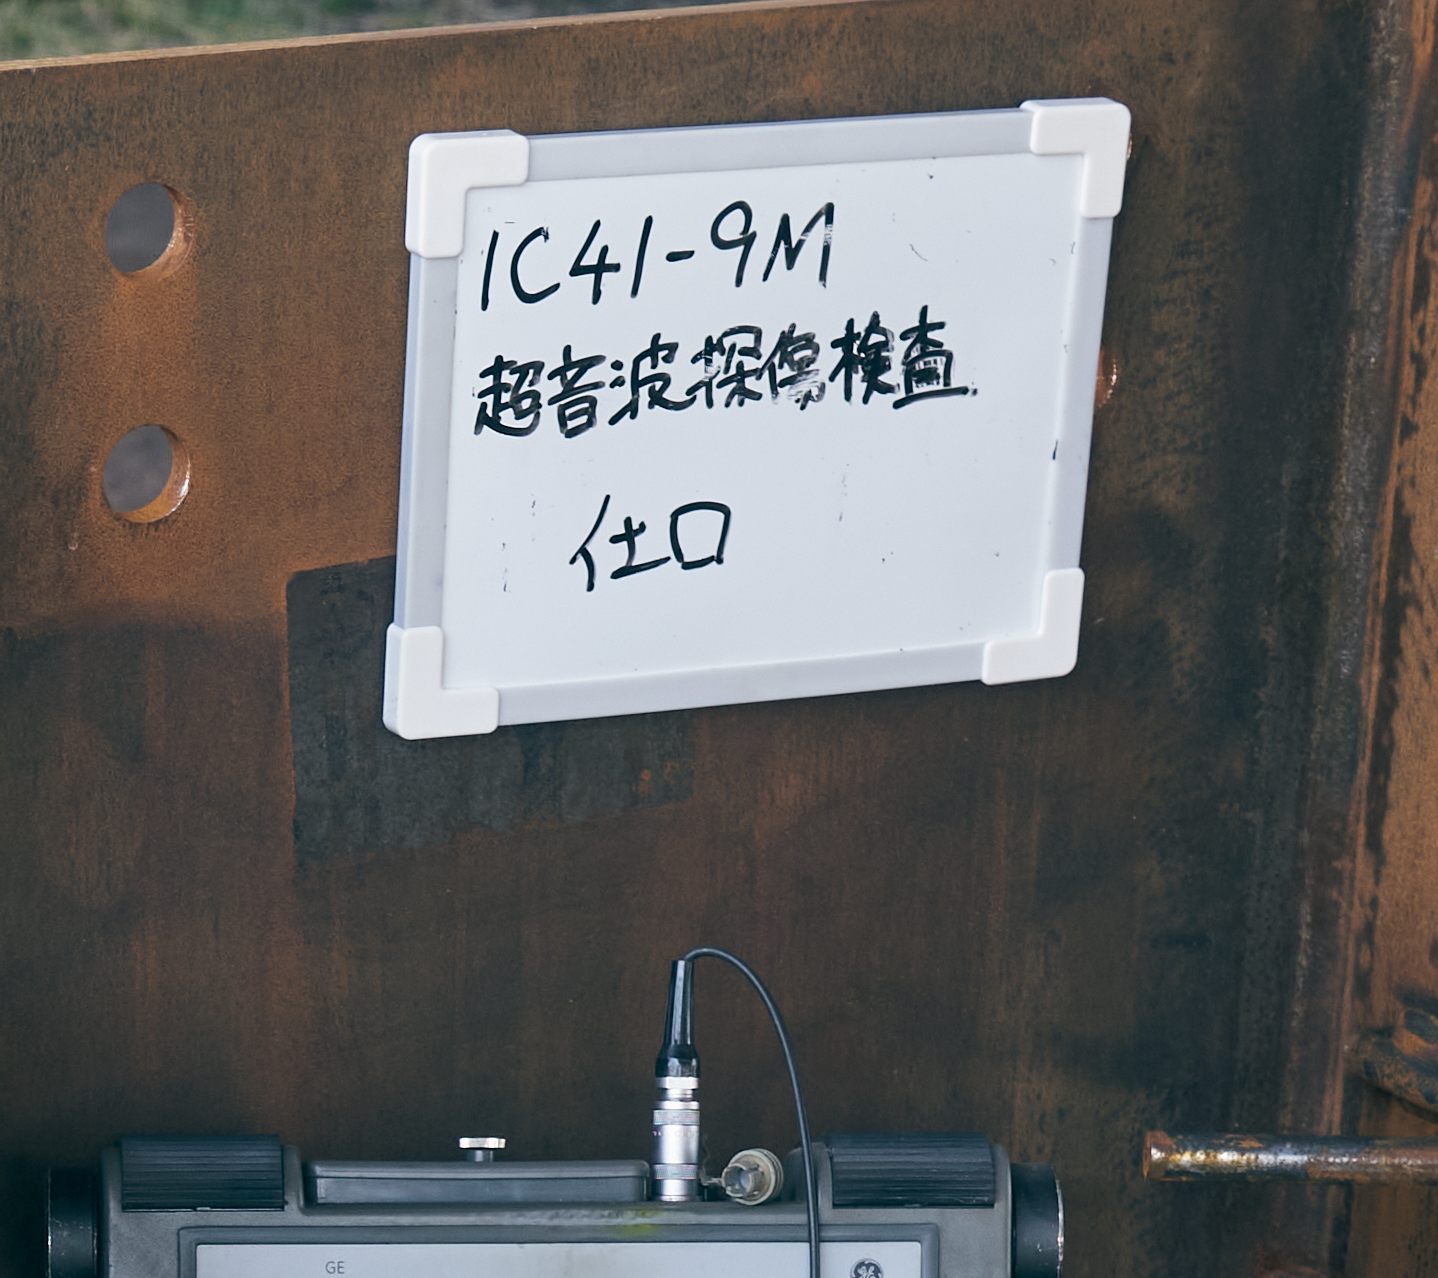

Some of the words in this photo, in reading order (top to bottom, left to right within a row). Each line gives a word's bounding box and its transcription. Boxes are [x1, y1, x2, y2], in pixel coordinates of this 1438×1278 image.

[473, 305, 977, 438] 超音波探傷検査
[568, 493, 732, 592] 仕口
[325, 1261, 345, 1275] GE
